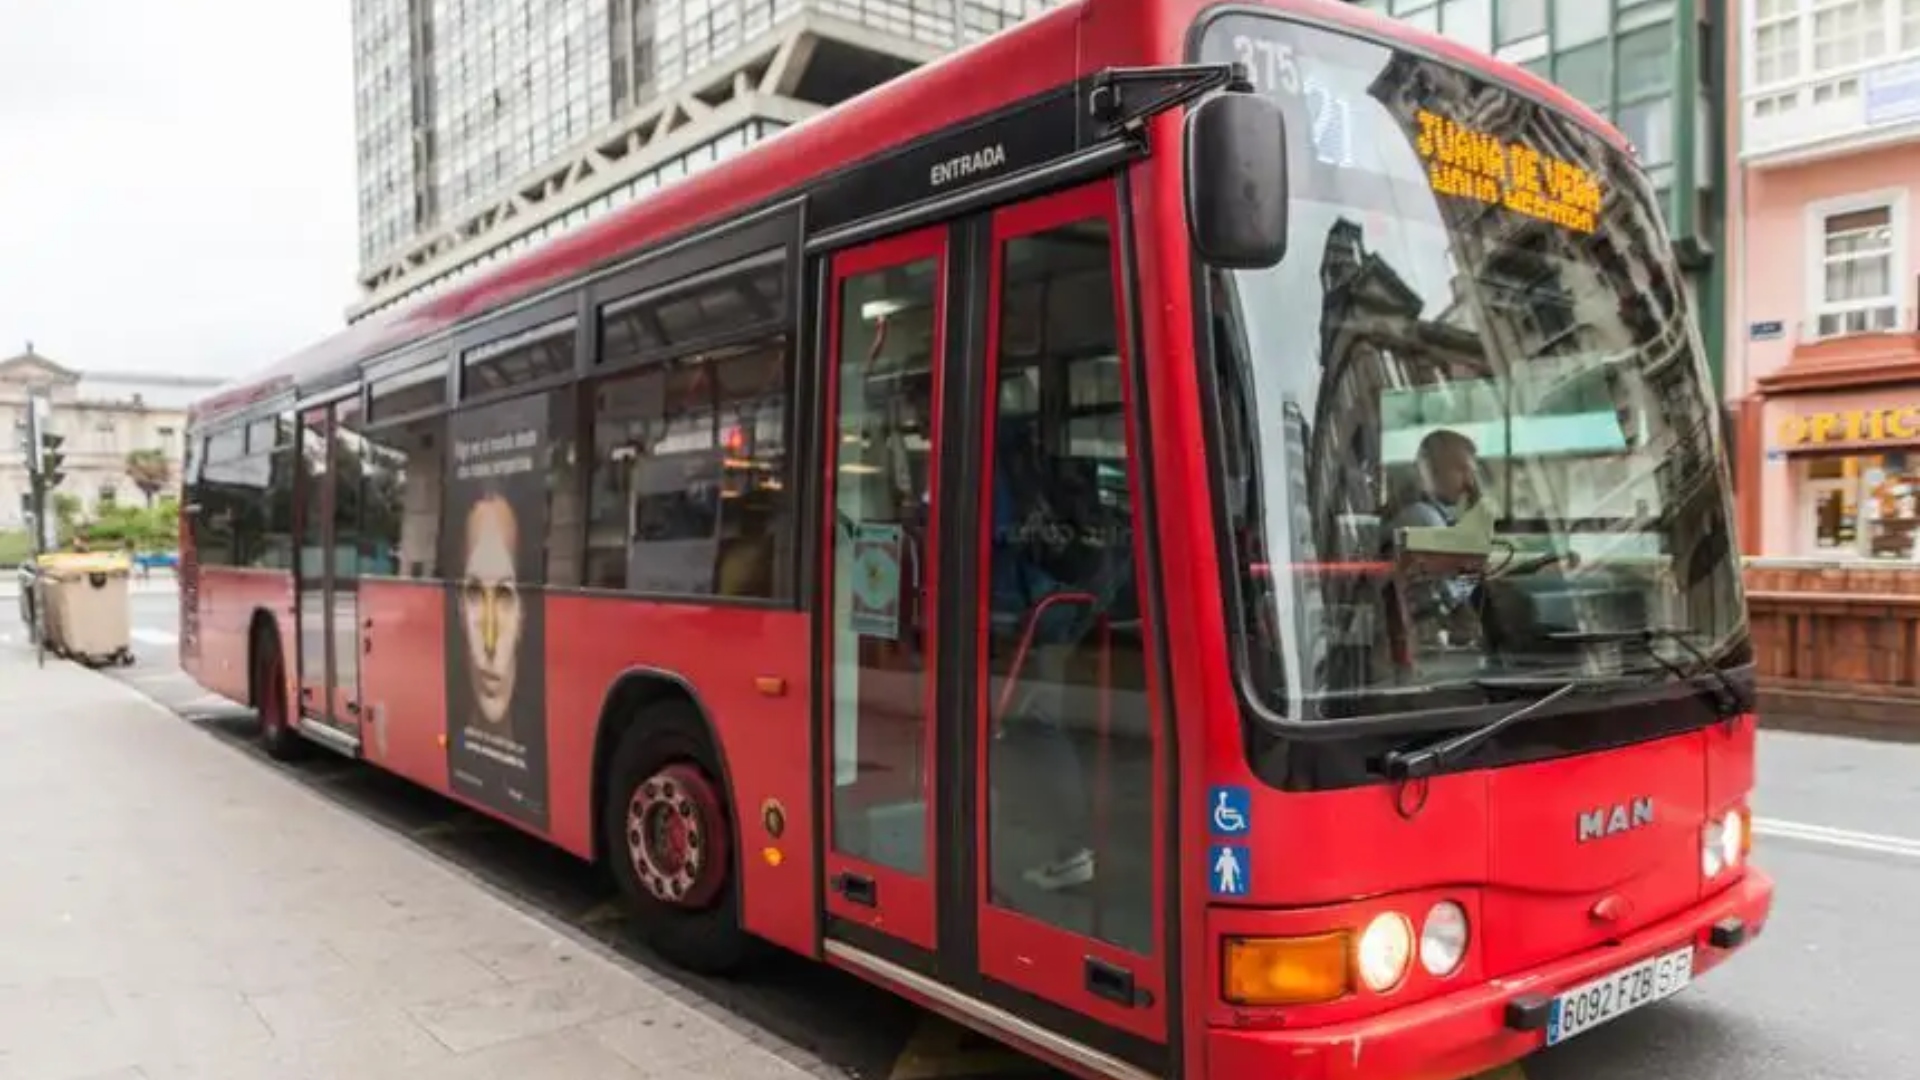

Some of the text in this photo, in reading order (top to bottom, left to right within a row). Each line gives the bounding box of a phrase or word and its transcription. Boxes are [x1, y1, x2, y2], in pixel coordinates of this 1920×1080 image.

[1232, 35, 1299, 95] 375
[1303, 78, 1353, 167] 21
[930, 143, 1005, 186] ENTRADA
[1510, 142, 1541, 194] DE
[1576, 795, 1654, 843] MAN
[1564, 983, 1613, 1032] 6092
[1617, 968, 1652, 1011] FZB
